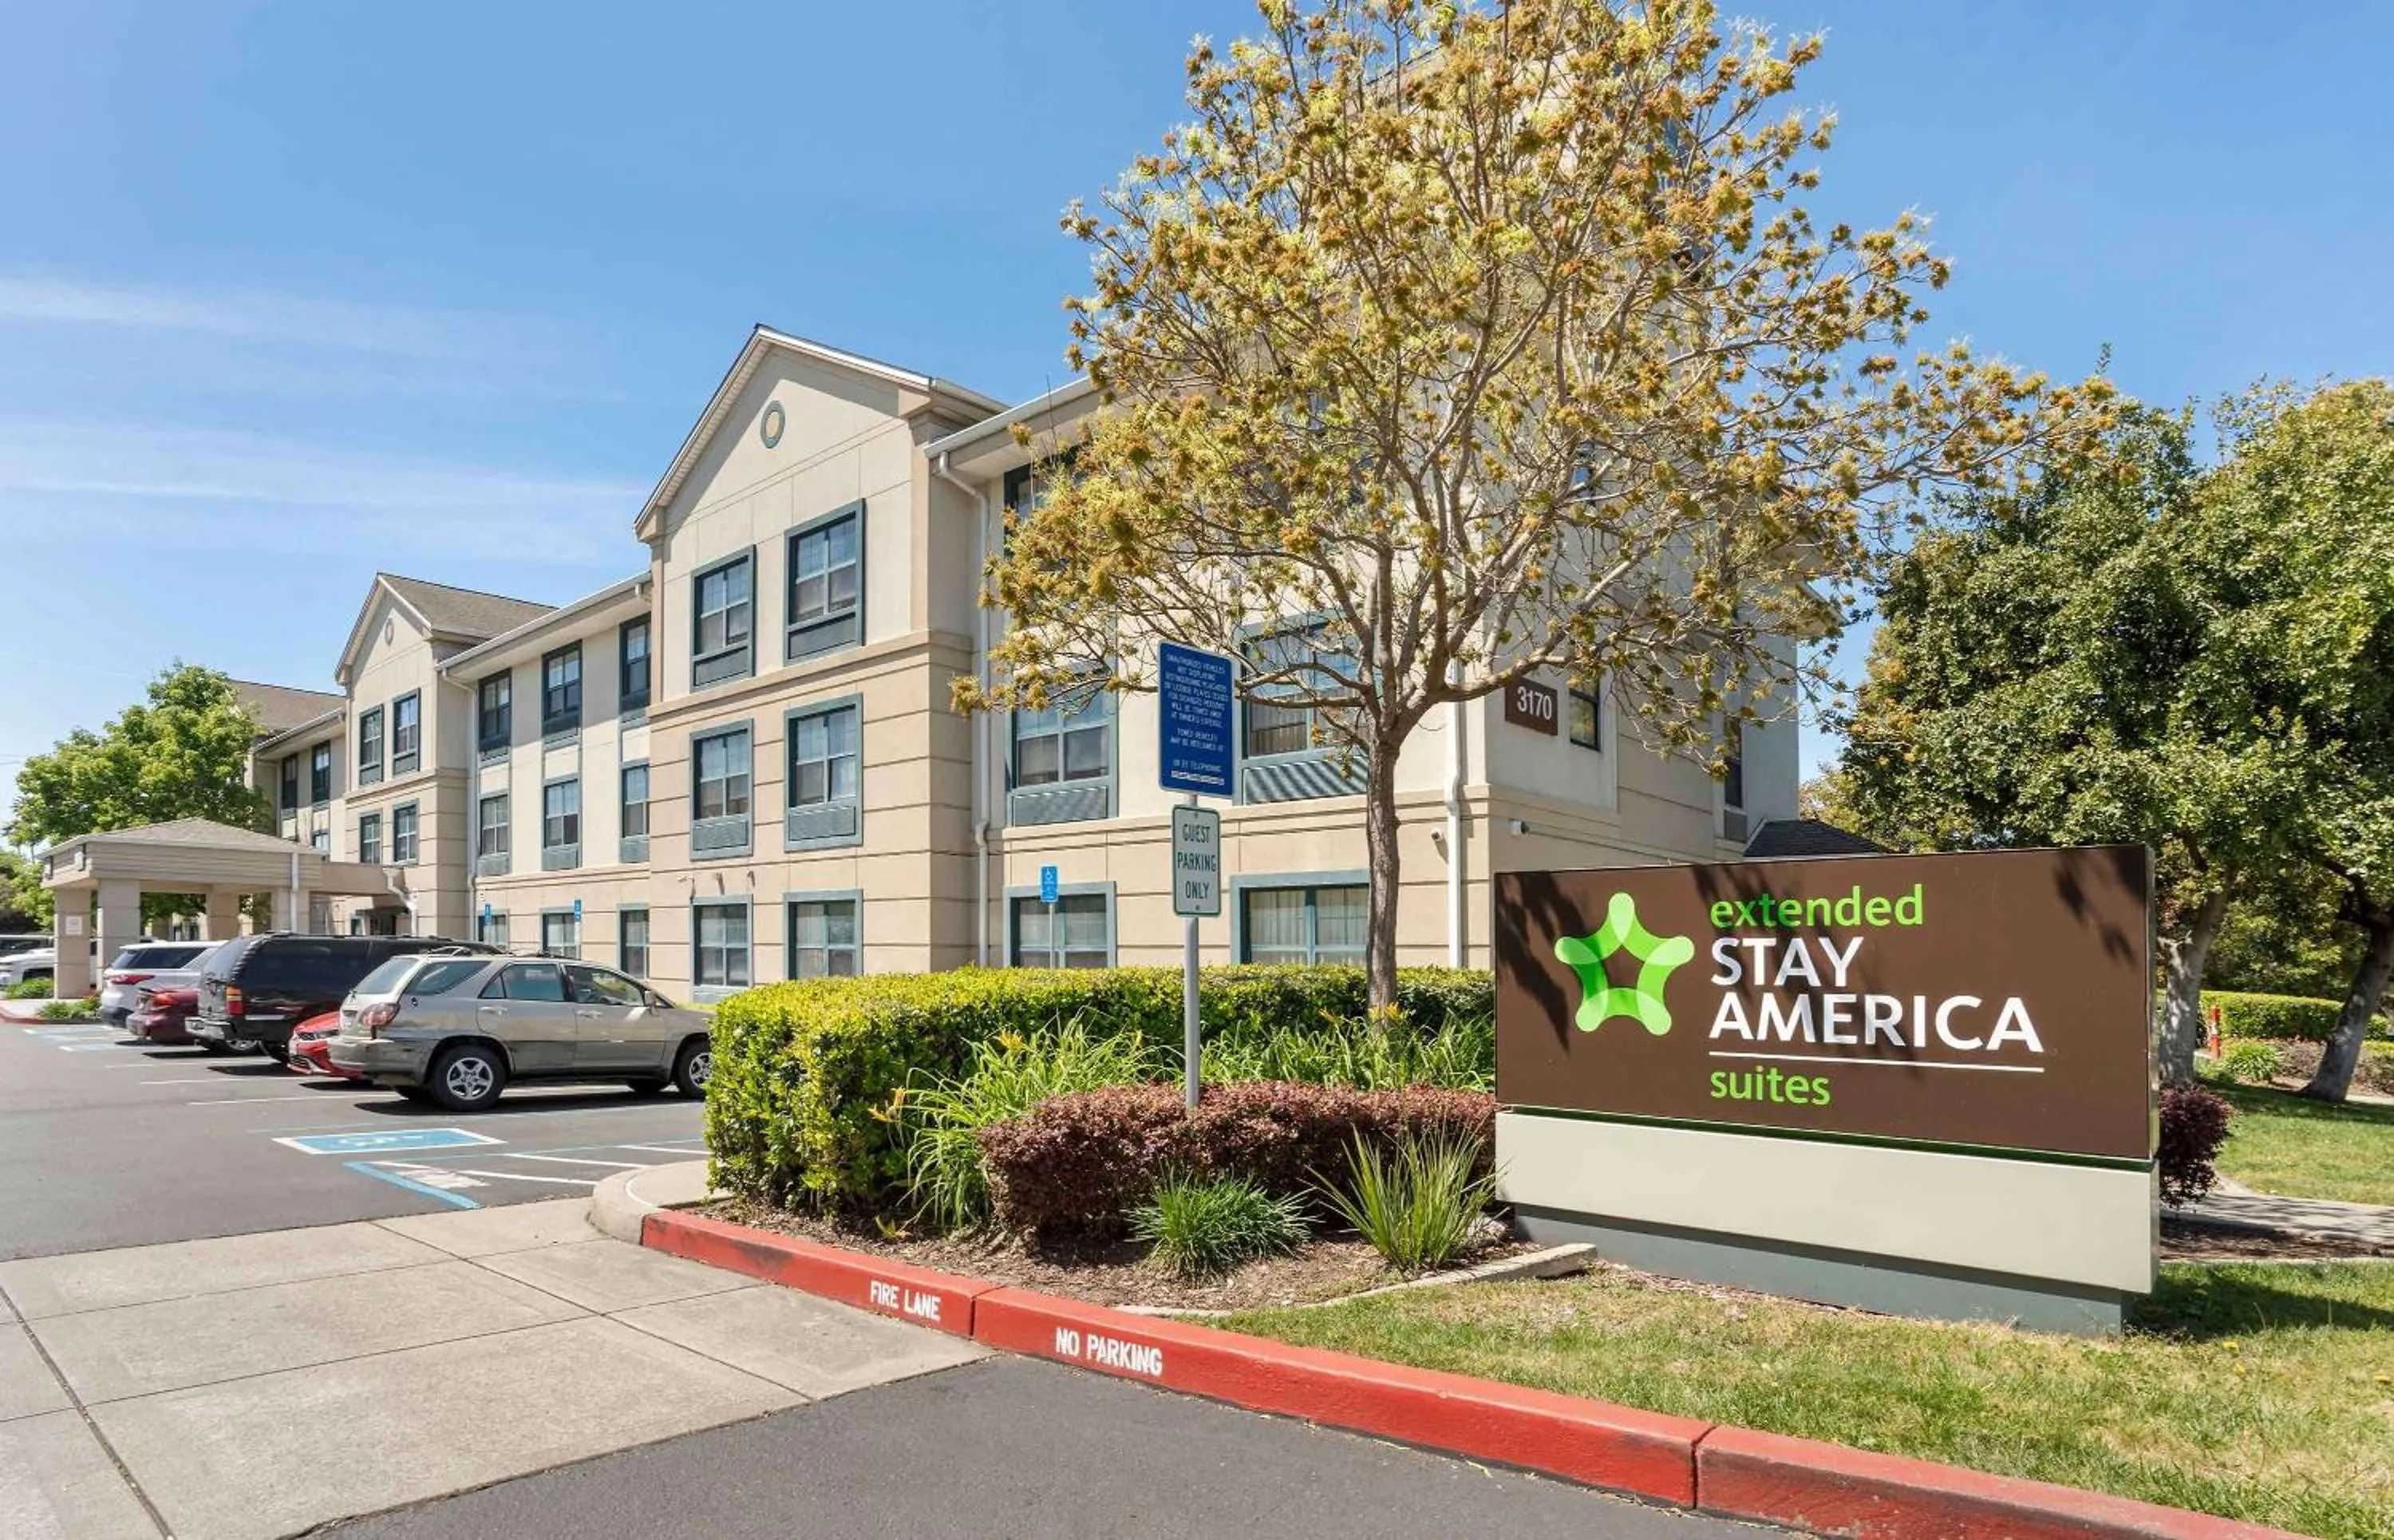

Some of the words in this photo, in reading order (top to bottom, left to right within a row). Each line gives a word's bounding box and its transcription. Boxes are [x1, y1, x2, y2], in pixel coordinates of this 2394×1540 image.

[1517, 685, 1552, 721] 3170
[1182, 823, 1211, 843] GUEST
[1177, 851, 1217, 872] PARKING
[1185, 880, 1210, 899] ONLY
[1710, 883, 1924, 928] extended
[1711, 936, 1865, 988] STAY
[1709, 992, 2044, 1052] AMERICA
[1710, 1065, 1830, 1106] suites
[870, 1281, 899, 1309] FIRE
[904, 1289, 941, 1321] LANE
[1056, 1327, 1080, 1356] NO
[1087, 1333, 1163, 1376] PARKING
